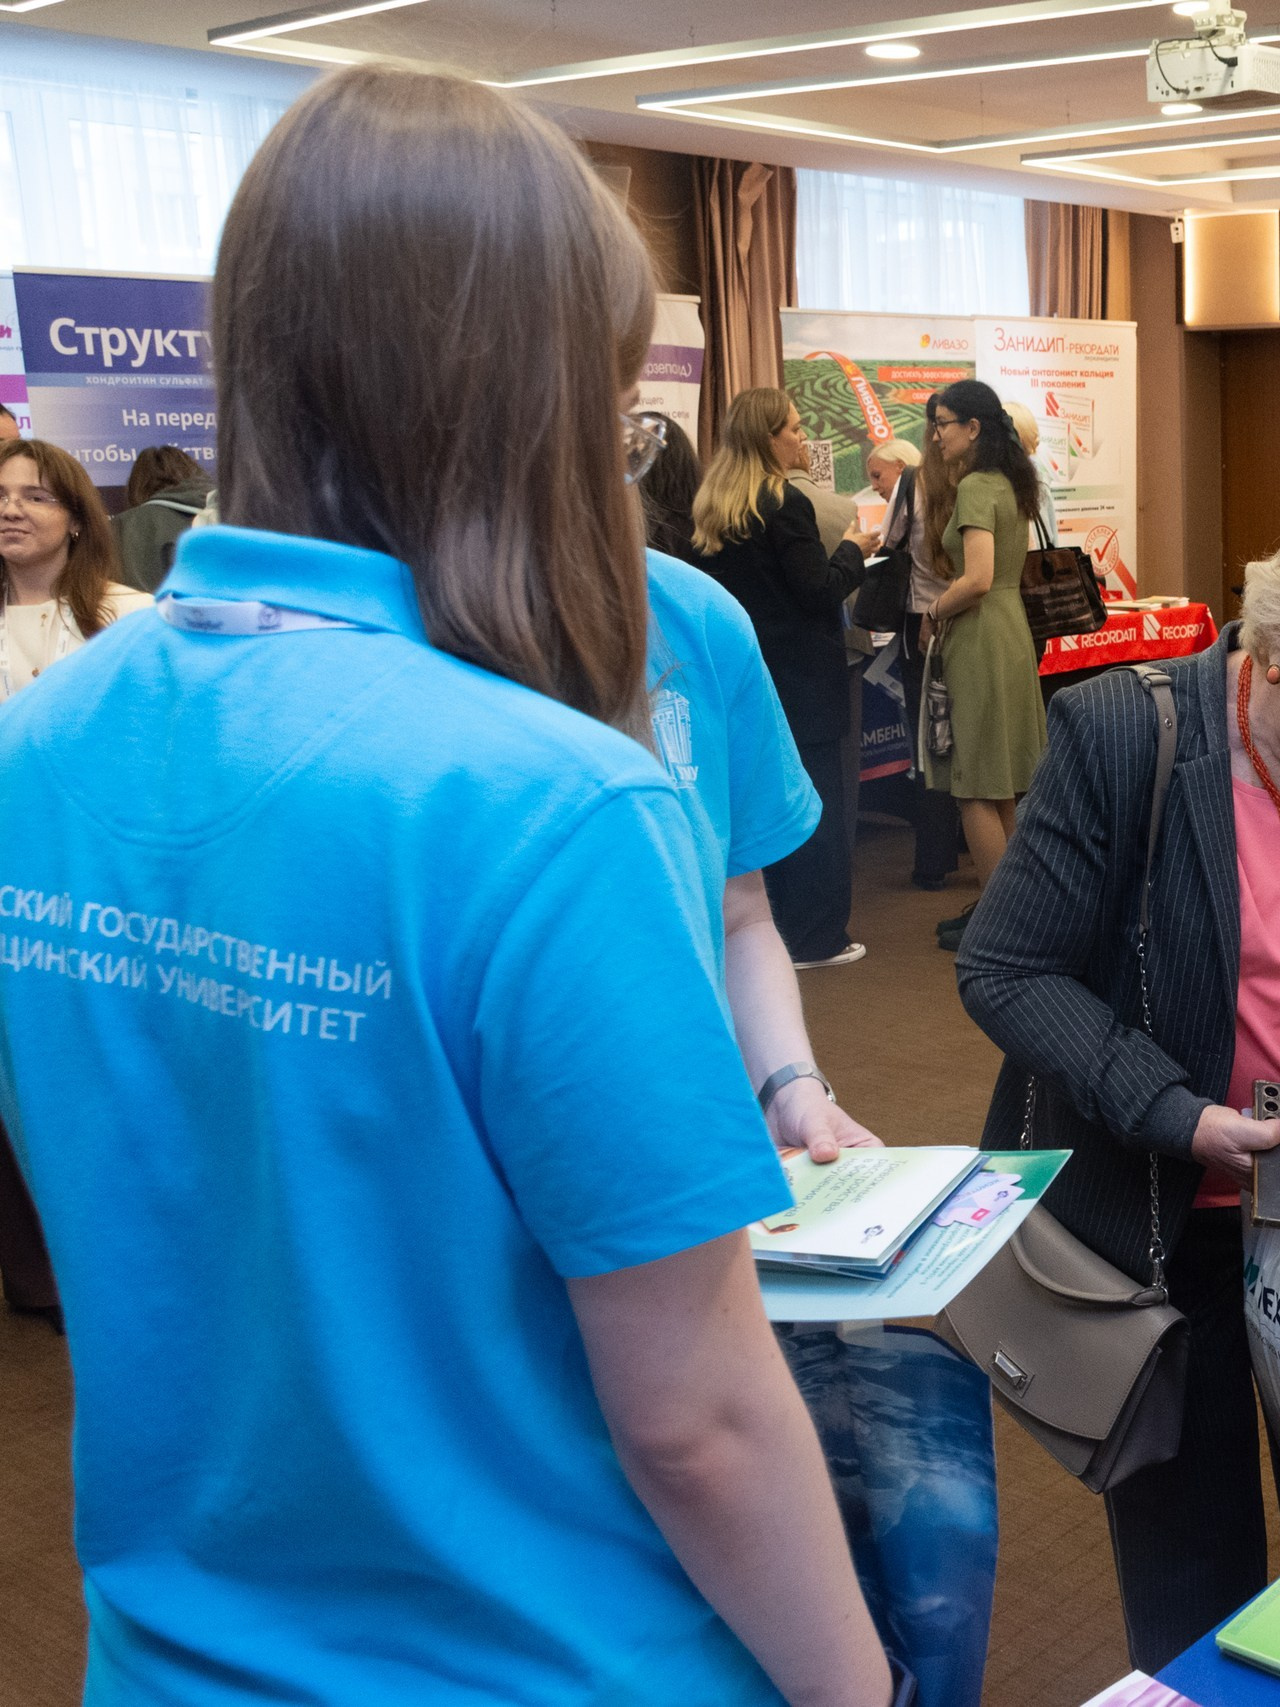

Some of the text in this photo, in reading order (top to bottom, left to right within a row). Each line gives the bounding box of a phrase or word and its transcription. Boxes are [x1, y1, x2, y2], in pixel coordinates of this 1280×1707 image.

[86, 376, 203, 386] ХОНДРОИТИН СУЛЬФАТ
[1000, 366, 1030, 377] Новый
[1079, 370, 1115, 379] кальция
[1030, 378, 1086, 389] III поколения
[122, 409, 150, 426] На
[1081, 628, 1137, 648] RECORDATI
[79, 901, 392, 1000] ГОСУДАРСТВЕННЫЙ
[156, 963, 366, 1043] УНИВЕРСИТЕТ
